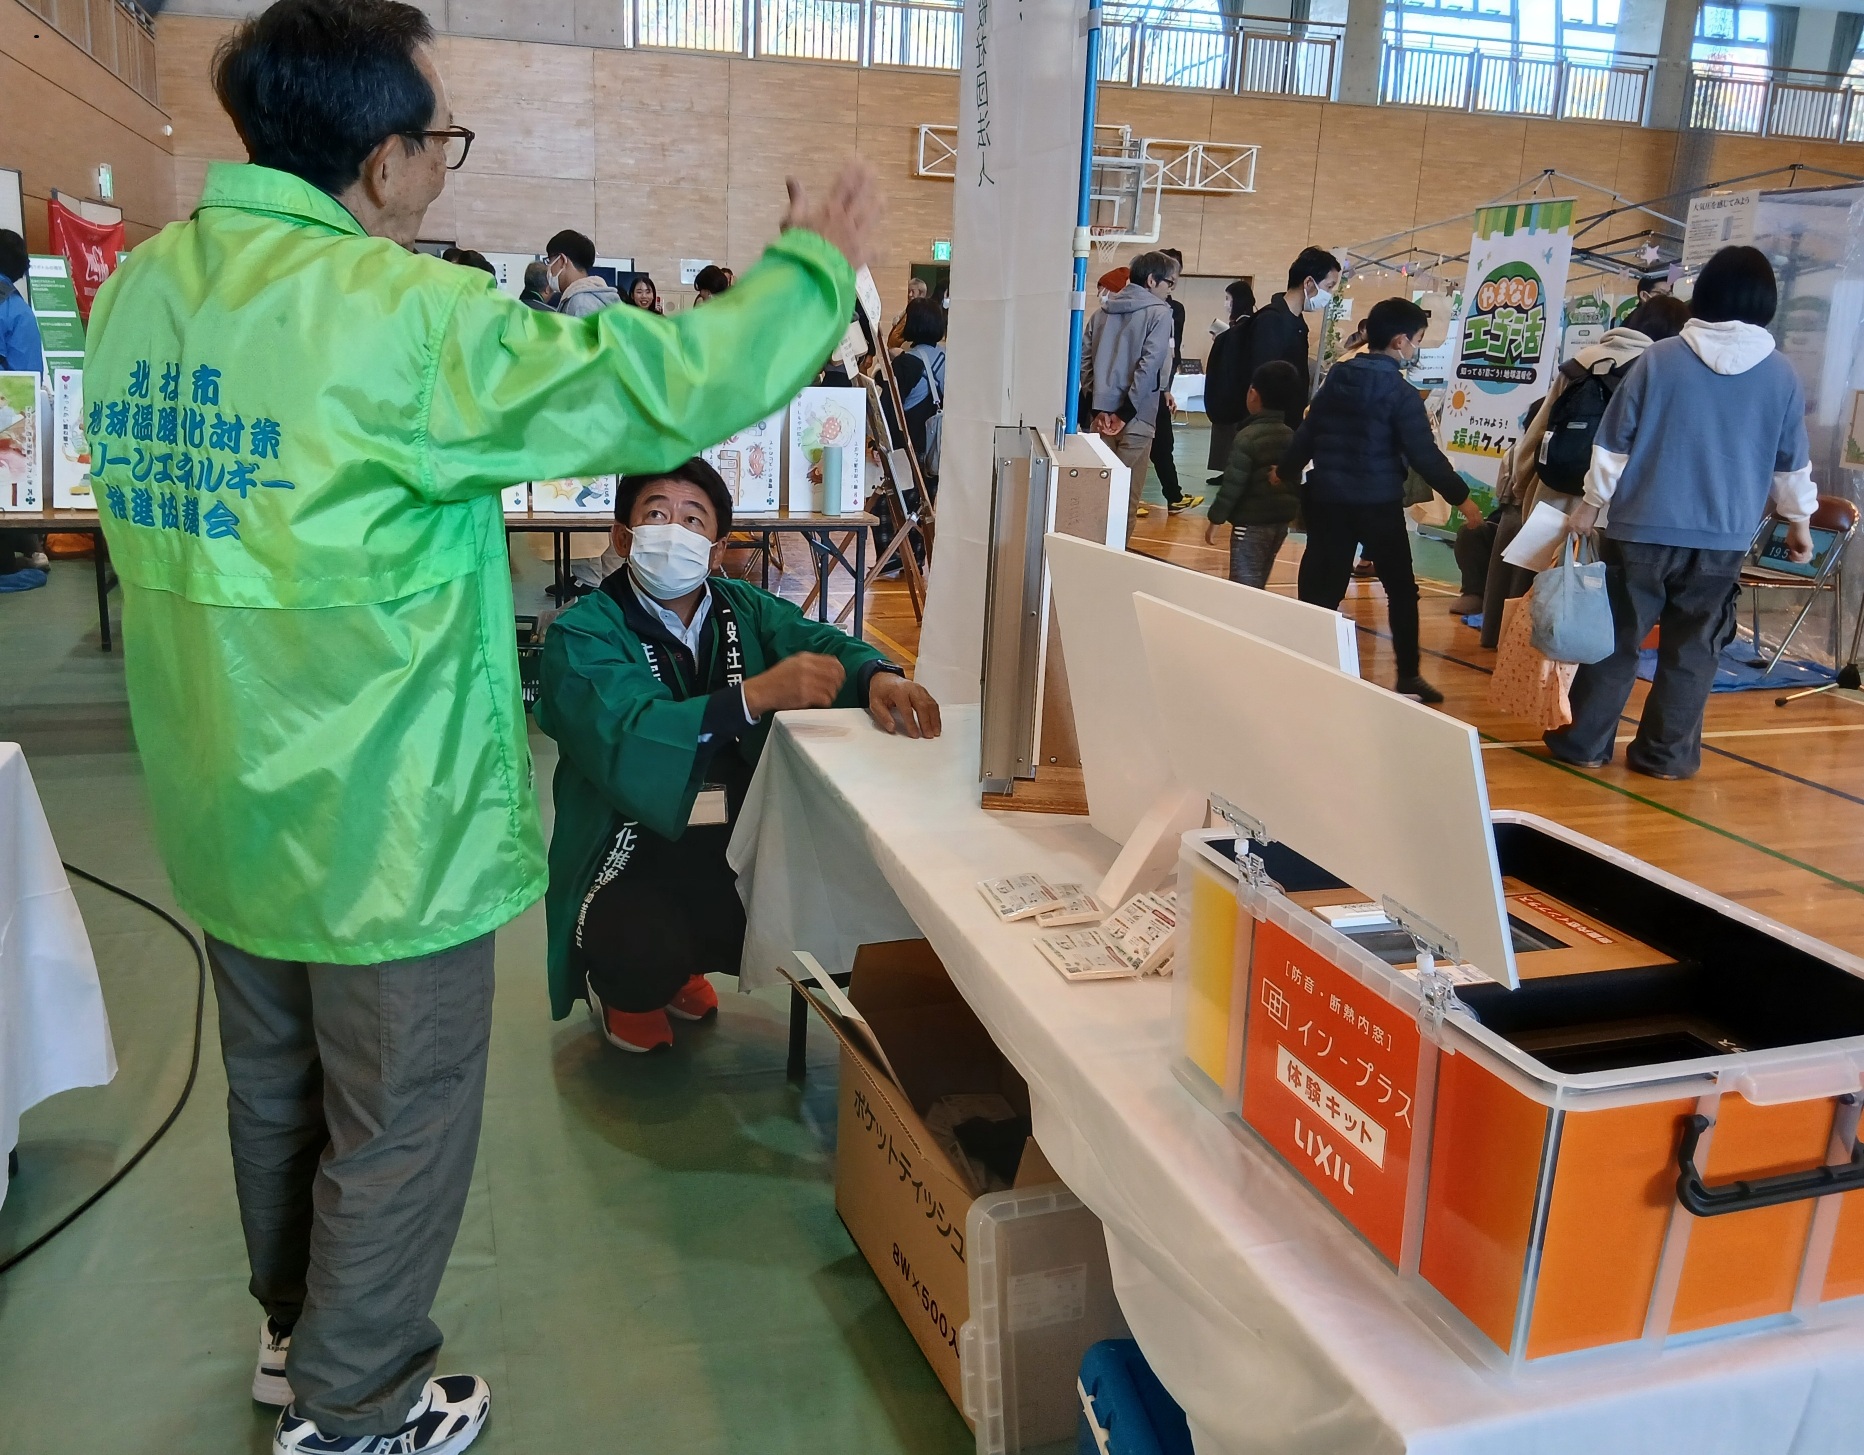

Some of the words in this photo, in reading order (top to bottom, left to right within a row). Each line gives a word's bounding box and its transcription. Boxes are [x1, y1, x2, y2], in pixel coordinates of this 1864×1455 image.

[1481, 280, 1533, 308] やまなし
[1469, 416, 1509, 429] やってみよう!
[105, 484, 241, 540] 推進協議会
[1287, 1060, 1373, 1144] 体験キット
[854, 1089, 966, 1264] ポケットティッシュ
[1293, 1117, 1355, 1196] LIXIL
